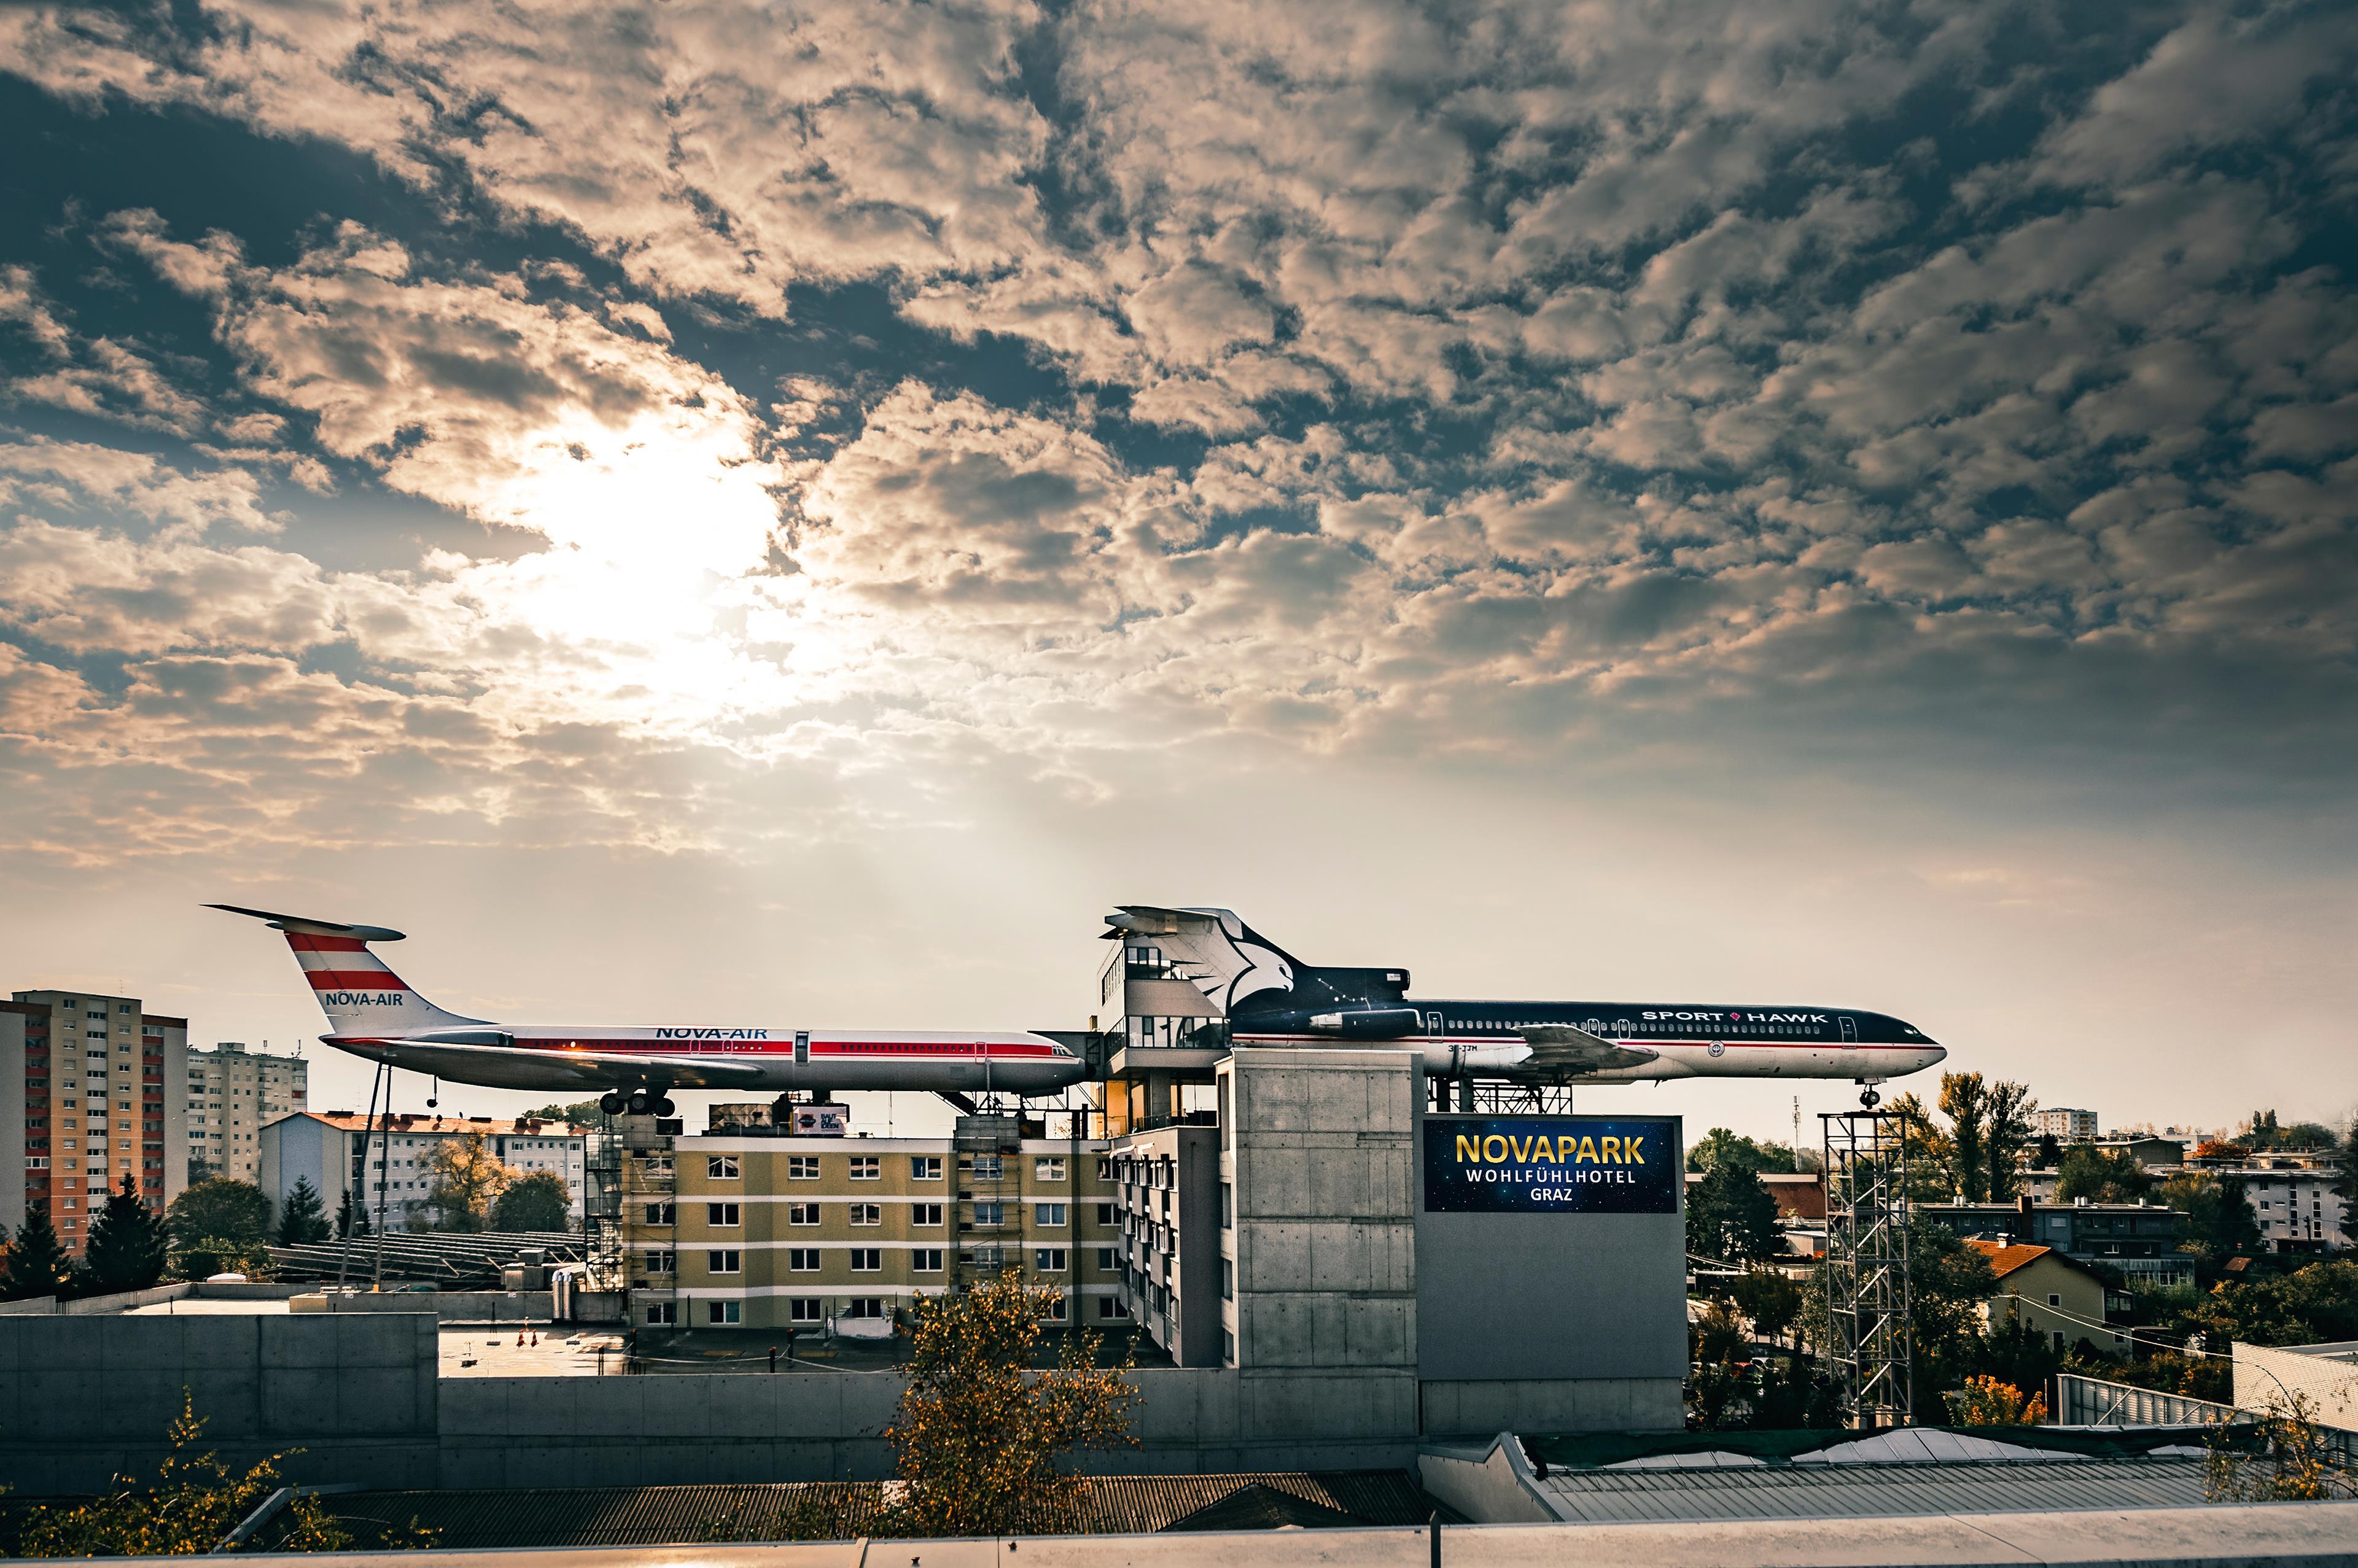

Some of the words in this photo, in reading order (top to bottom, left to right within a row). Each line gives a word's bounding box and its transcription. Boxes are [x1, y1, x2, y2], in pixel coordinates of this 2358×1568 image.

[325, 993, 403, 1006] NOVA-AIR
[1641, 1011, 1724, 1022] SPORT
[1746, 1013, 1829, 1023] HAWK
[656, 1028, 768, 1039] NOVA-AIR
[1455, 1135, 1646, 1165] NOVAPARK
[1466, 1167, 1636, 1184] WOHLFÜHLHOTEL
[1530, 1187, 1573, 1201] GRAZ
